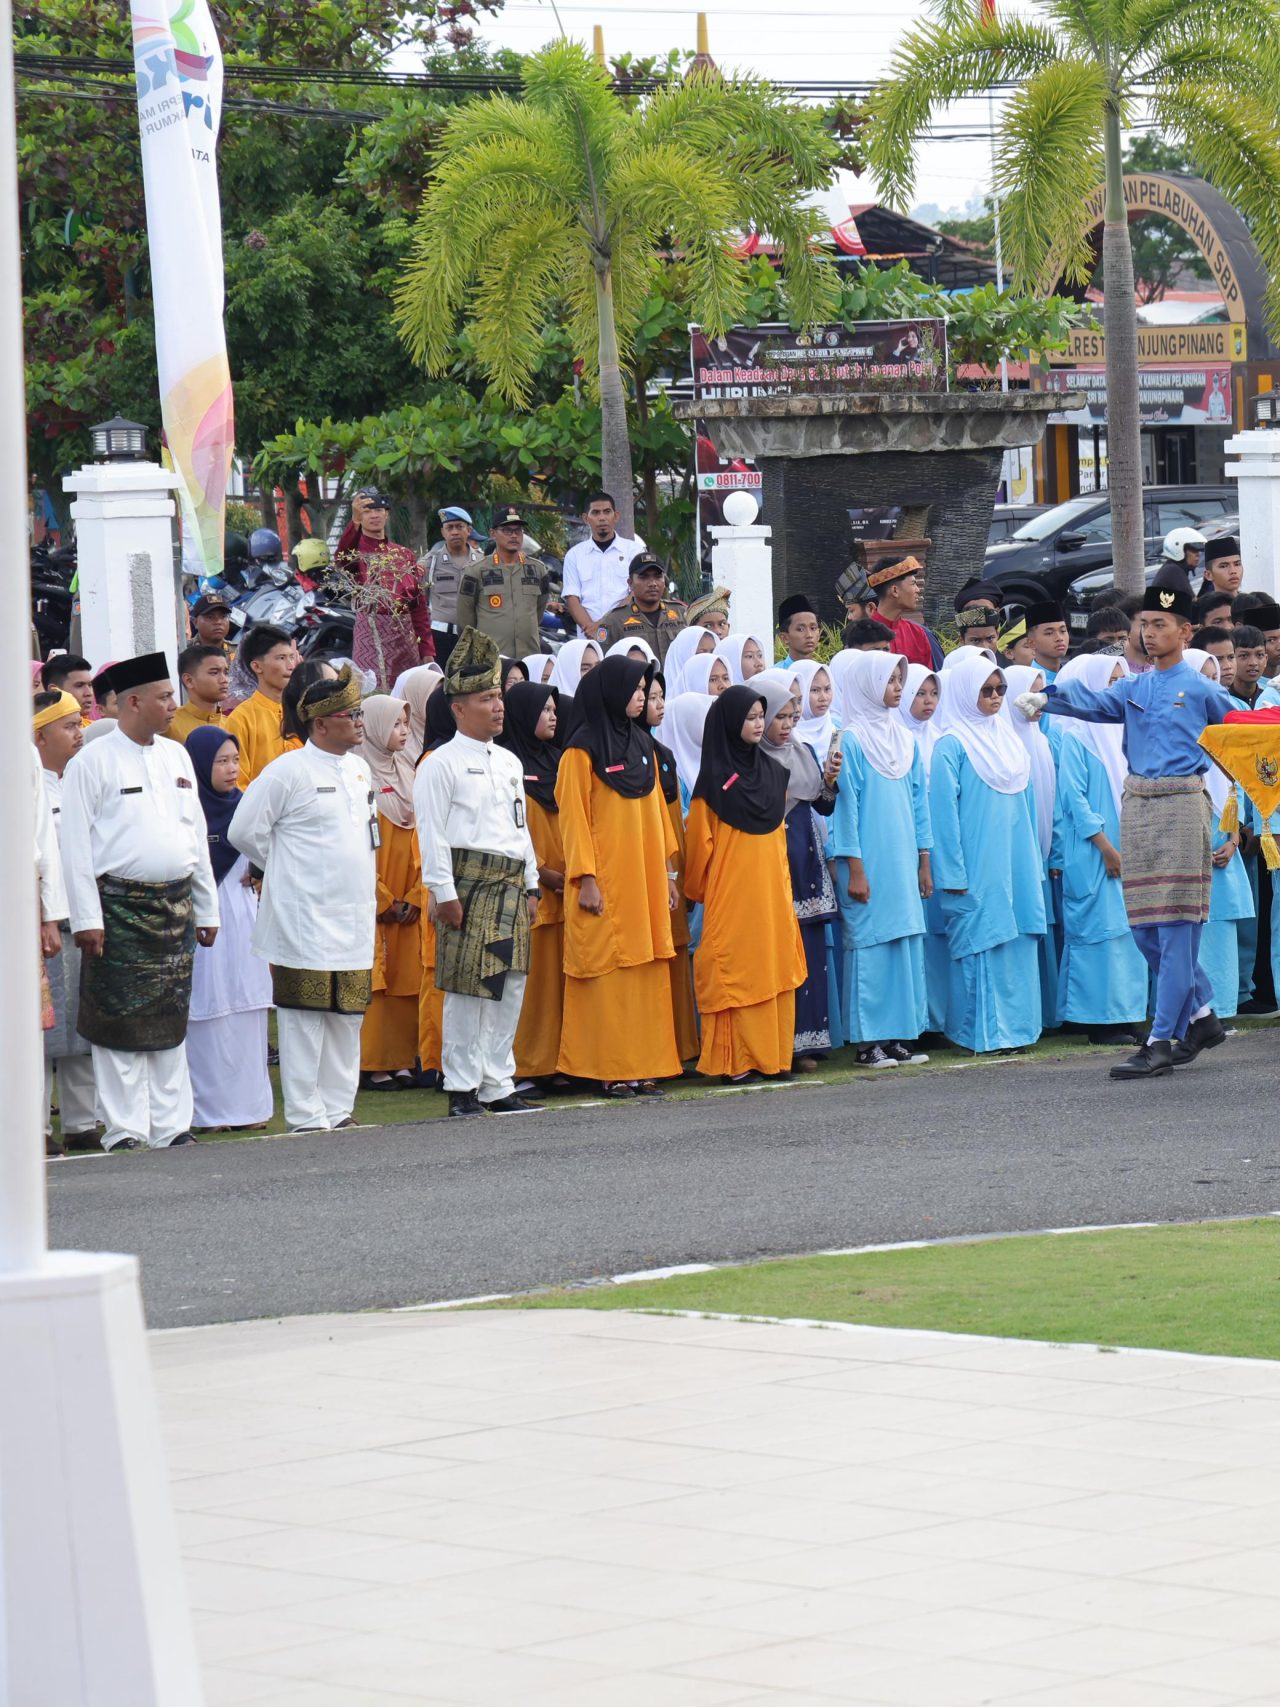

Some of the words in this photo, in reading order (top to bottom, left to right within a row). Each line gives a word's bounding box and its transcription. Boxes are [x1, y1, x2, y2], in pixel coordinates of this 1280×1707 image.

[1140, 180, 1216, 257] PELABUHAN
[1213, 251, 1239, 303] SBP
[700, 367, 733, 384] Dalam
